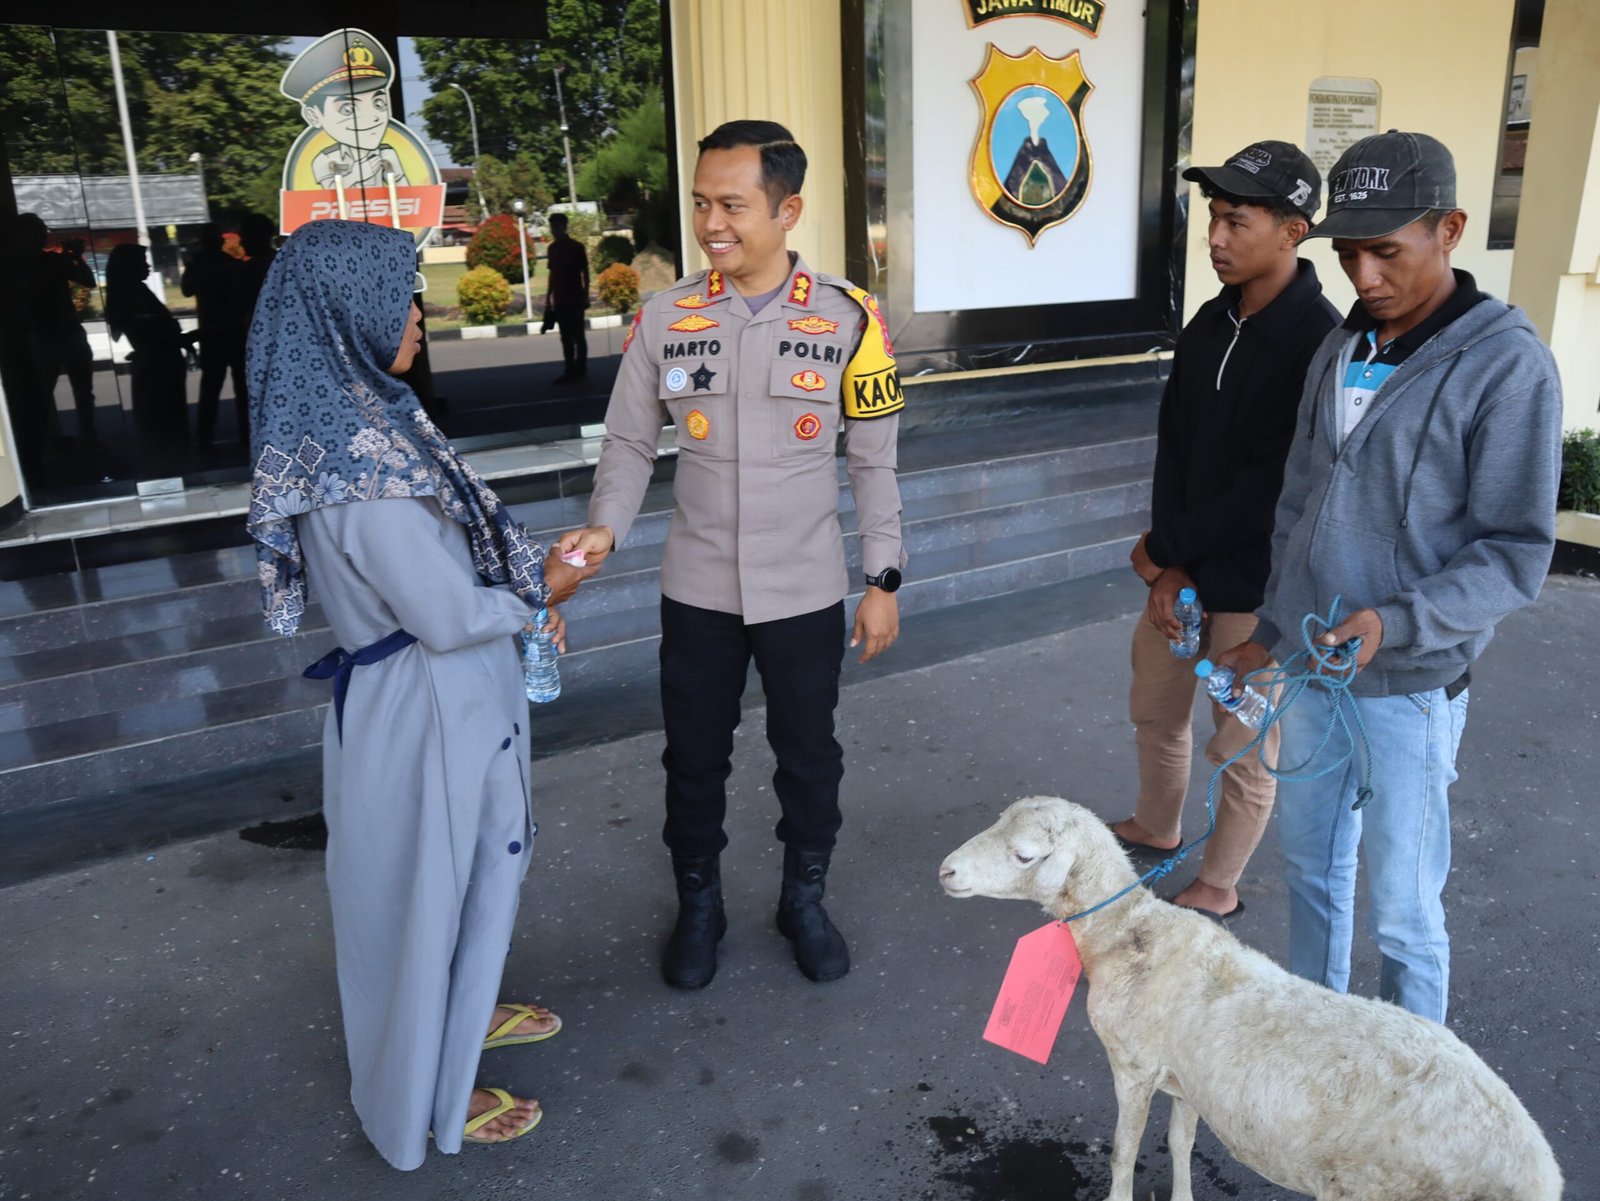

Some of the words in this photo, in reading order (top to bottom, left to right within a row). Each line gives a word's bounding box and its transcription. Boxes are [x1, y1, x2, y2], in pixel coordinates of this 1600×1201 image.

[1350, 166, 1390, 191] YORK
[310, 197, 421, 221] PRESSI
[663, 339, 721, 360] HARTO
[779, 341, 842, 364] POLRI
